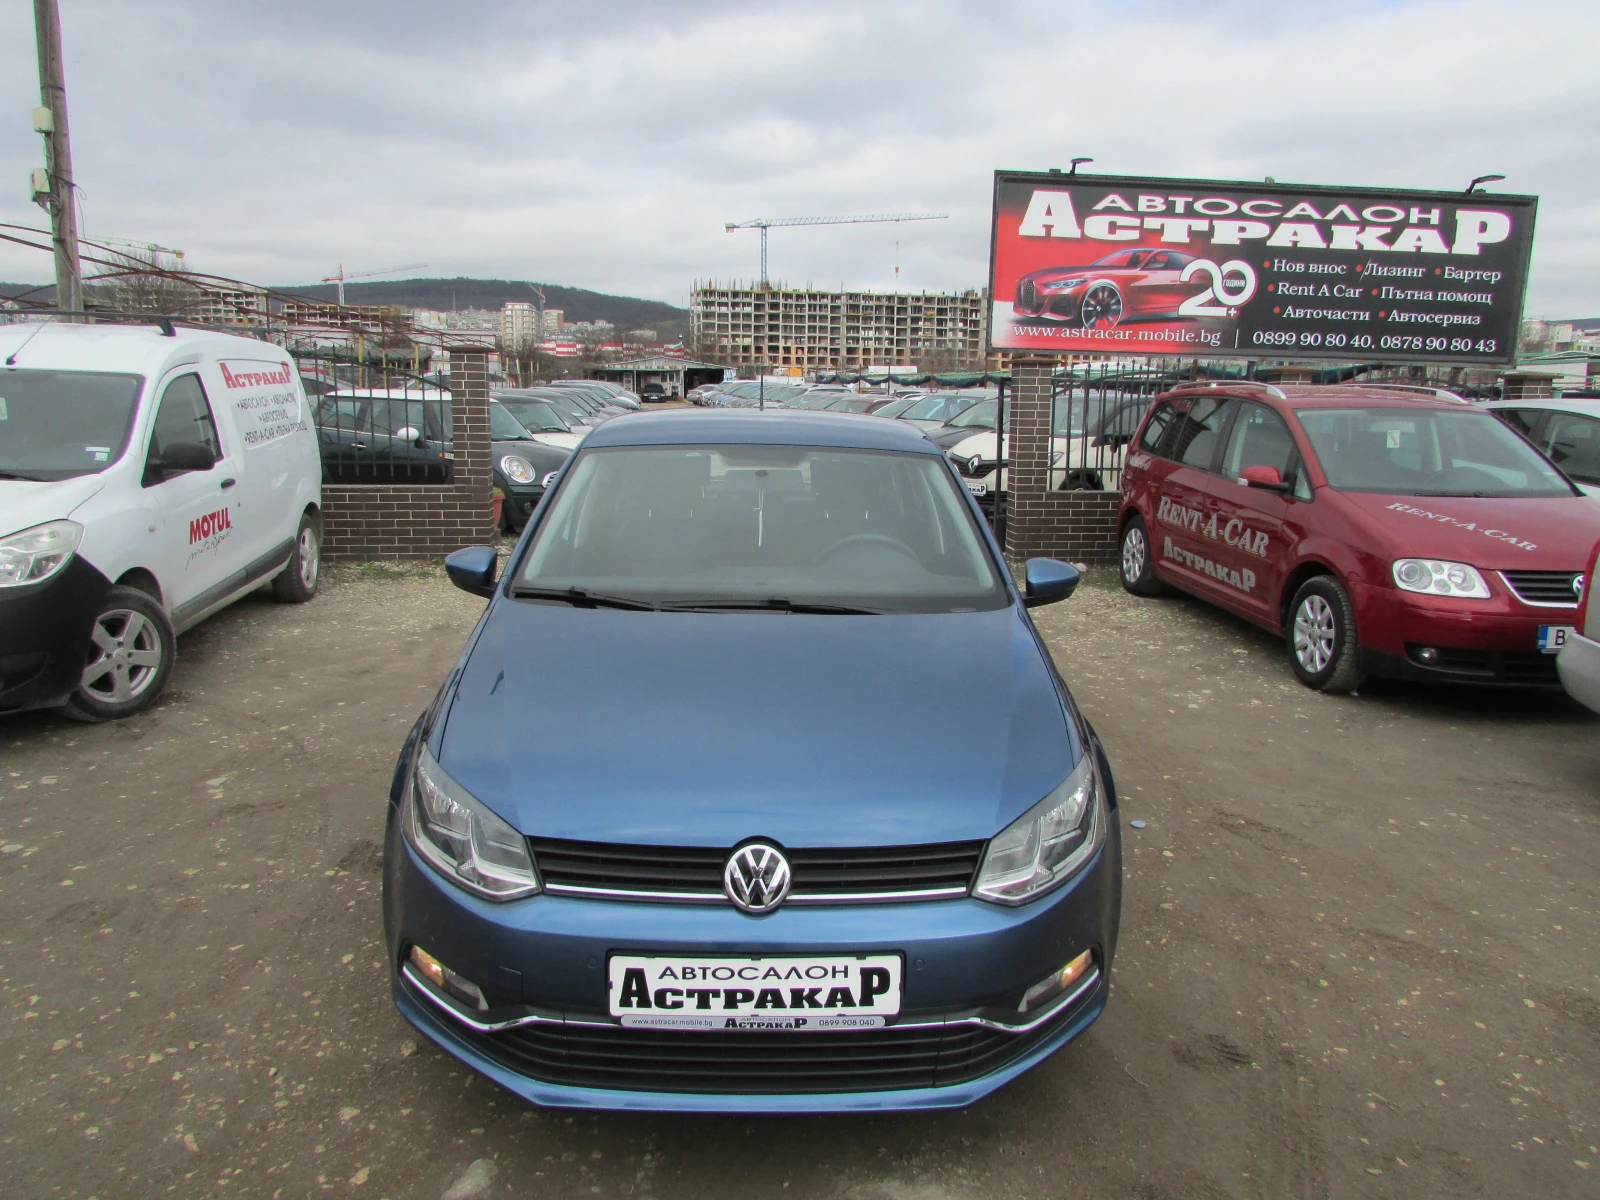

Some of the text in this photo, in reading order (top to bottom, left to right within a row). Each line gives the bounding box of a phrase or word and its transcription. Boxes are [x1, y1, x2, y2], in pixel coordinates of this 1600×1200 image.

[1092, 194, 1441, 225] АВТОСАЛОН
[1272, 259, 1501, 284] Нов внос Лизинг Бартер
[1222, 279, 1246, 288] ГОДИНИ
[1277, 282, 1363, 298] Rent A Car
[1380, 286, 1492, 305] Пътна помощ
[1282, 305, 1481, 326] Авточасти Автосервиз
[1013, 325, 1222, 347] www.astracar.mobile.bg
[1252, 331, 1497, 352] 0899 90 80 40, 0878 90 80 43
[189, 507, 231, 545] MOTUL
[657, 964, 849, 981] АВТОСАЛОН
[631, 1017, 714, 1027] www.astracar.mobile.bg
[818, 1018, 875, 1027] 0899 908 040
